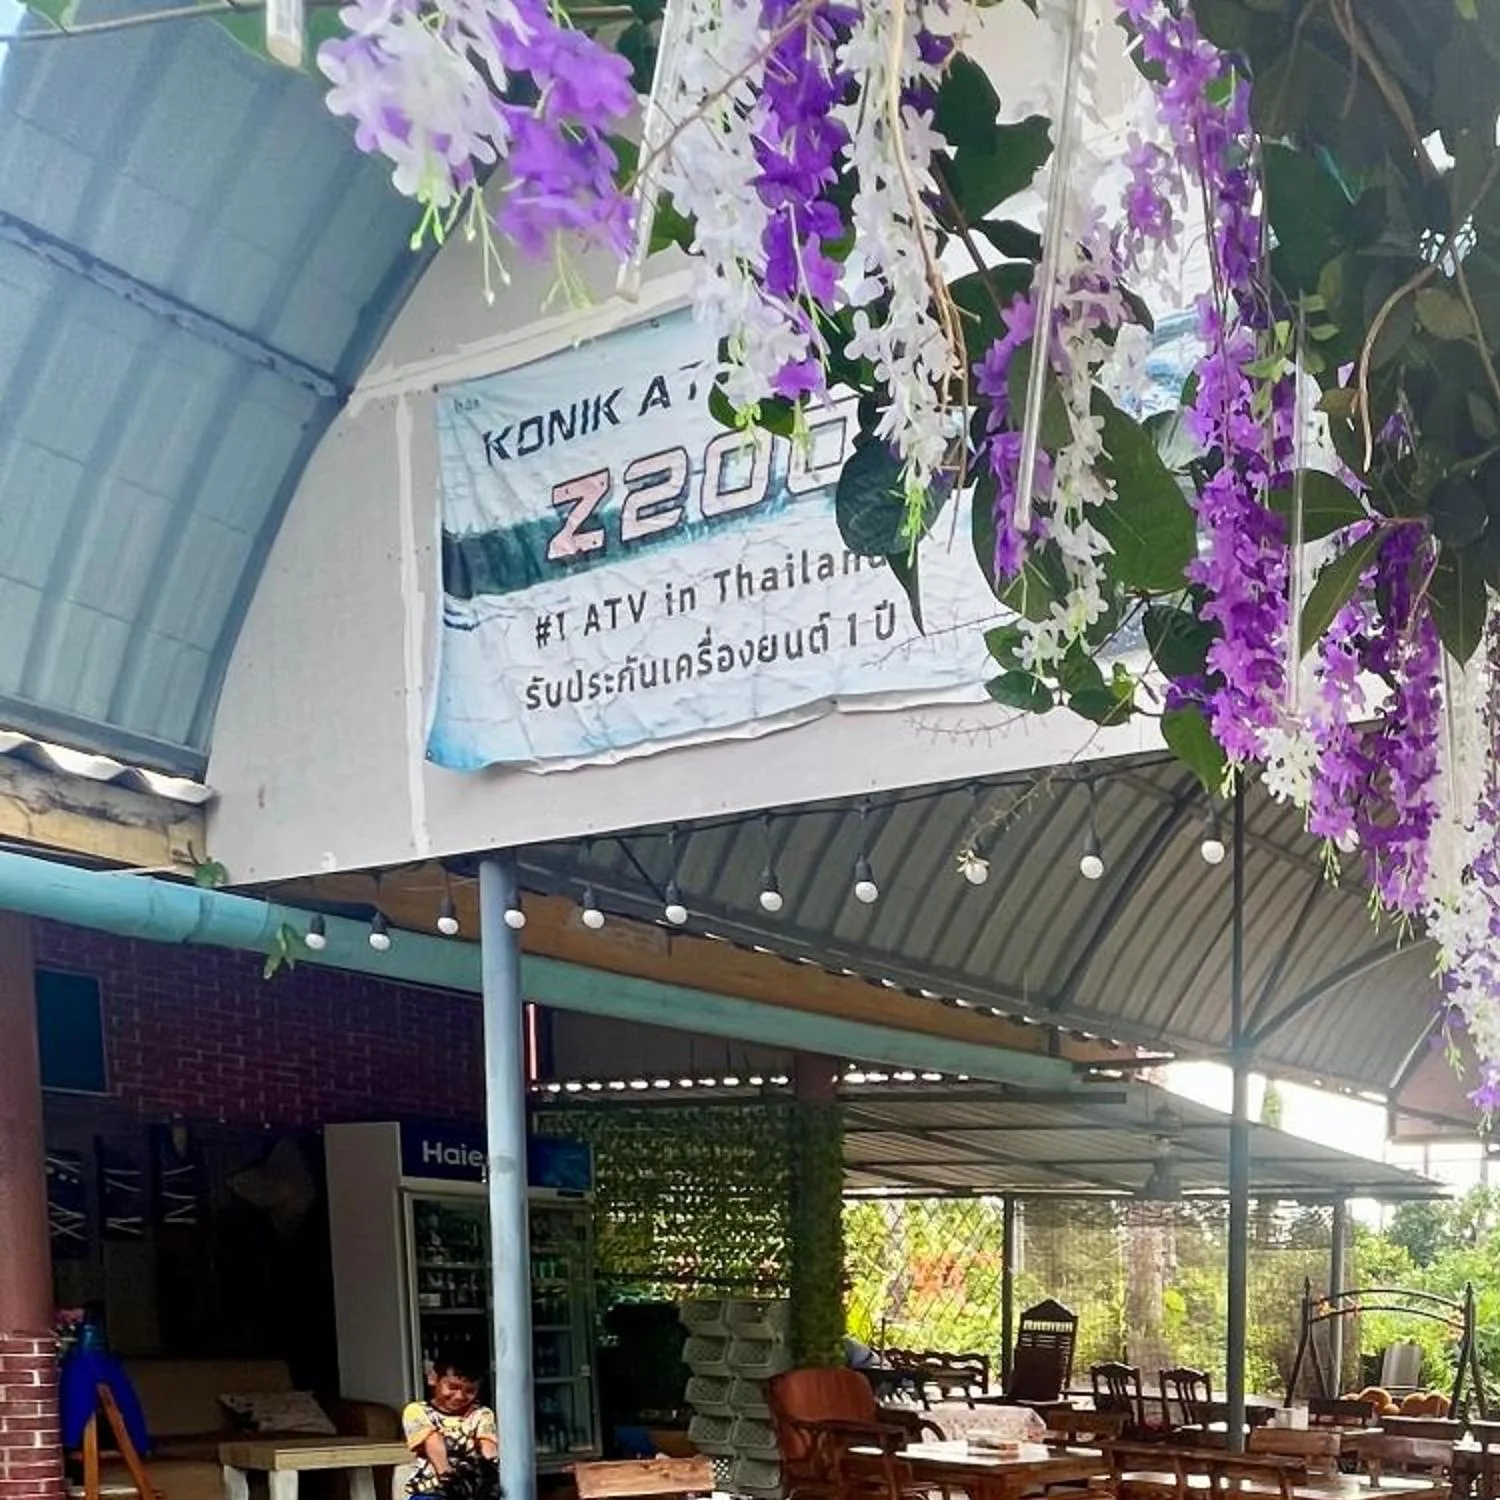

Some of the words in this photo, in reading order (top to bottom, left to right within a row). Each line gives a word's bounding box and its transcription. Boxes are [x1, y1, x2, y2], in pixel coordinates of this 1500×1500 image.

[482, 386, 624, 466] KONIK
[638, 359, 705, 417] AT
[547, 393, 863, 561] Z200
[526, 611, 831, 711] รับประกันเครื่องยนต์
[847, 612, 857, 647] 1
[874, 599, 896, 641] ปี
[535, 611, 566, 649] #1
[584, 590, 647, 637] ATV
[665, 582, 696, 617] in
[421, 1139, 487, 1167] Haie
